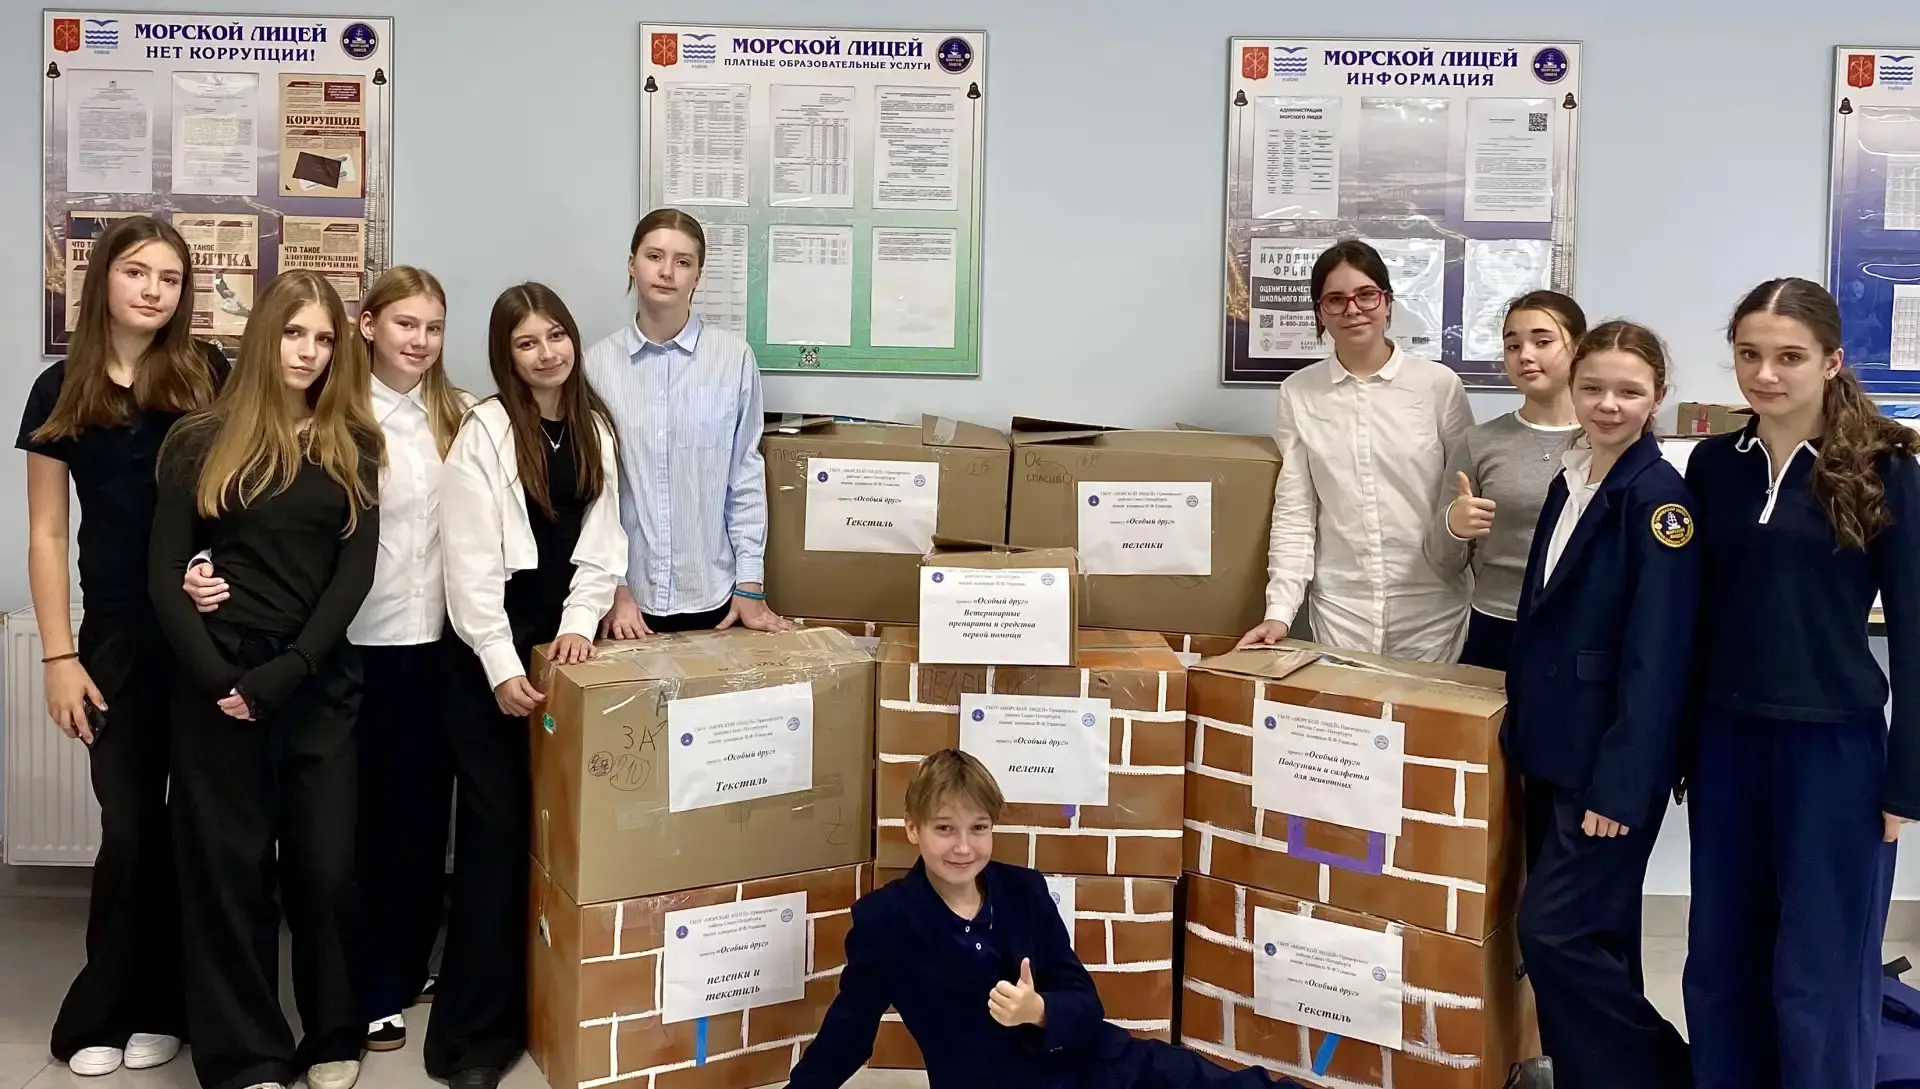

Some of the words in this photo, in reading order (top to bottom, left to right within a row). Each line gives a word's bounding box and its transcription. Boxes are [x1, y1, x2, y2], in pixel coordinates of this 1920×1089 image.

[135, 21, 243, 41] МОРСКОЙ
[251, 23, 327, 45] ЛИЦЕЙ
[733, 35, 841, 55] МОРСКОЙ
[847, 37, 923, 60] ЛИЦЕЙ
[146, 45, 183, 59] НЕТ
[190, 46, 316, 63] КОРРУПЦИИ!
[1324, 46, 1434, 66] МОРСКОЙ
[1441, 48, 1518, 70] ЛИЦЕЙ
[724, 58, 776, 67] ПЛАТНЫЕ
[779, 59, 886, 69] ОБРАЗОВАТЕЛЬНЫЕ
[889, 61, 931, 70] УСЛУГИ
[1347, 72, 1494, 88] ИНФОРМАЦИЯ
[286, 115, 360, 126] КОРРУПЦИЯ
[284, 246, 298, 254] ЧТО
[299, 246, 321, 254] ТАКОЕ
[191, 252, 252, 267] ЗЯТКА
[1259, 285, 1287, 294] ОЦЕНИТЕ
[1288, 285, 1311, 293] КАЧЕСТ
[1259, 295, 1298, 303] ШКОЛЬНОГО
[845, 516, 893, 527] Текстиль
[1156, 518, 1175, 526] друг»
[973, 596, 1007, 604] «Особый
[963, 608, 1020, 618] Ветеринарные
[1000, 621, 1036, 629] средства
[962, 631, 989, 639] первой
[1013, 736, 1047, 744] «Особый
[1048, 738, 1069, 747] друг»
[723, 750, 756, 761] «Особый
[756, 749, 776, 758] друг»
[1304, 750, 1338, 762] «Особый
[1339, 756, 1361, 766] друг»
[1008, 764, 1054, 773] пеленки
[1278, 757, 1322, 772] Подгузники
[1329, 769, 1370, 780] салфетки
[716, 777, 767, 791] Текстиль
[1293, 772, 1308, 780] для
[1308, 776, 1352, 788] животных
[716, 943, 749, 953] «Особый
[749, 941, 769, 950] друг»
[706, 970, 750, 984] пеленки
[753, 968, 760, 976] и
[705, 985, 760, 1001] текстиль
[1304, 979, 1338, 991] «Особый
[1338, 987, 1360, 996] друг»
[1297, 1001, 1351, 1022] Текстиль
